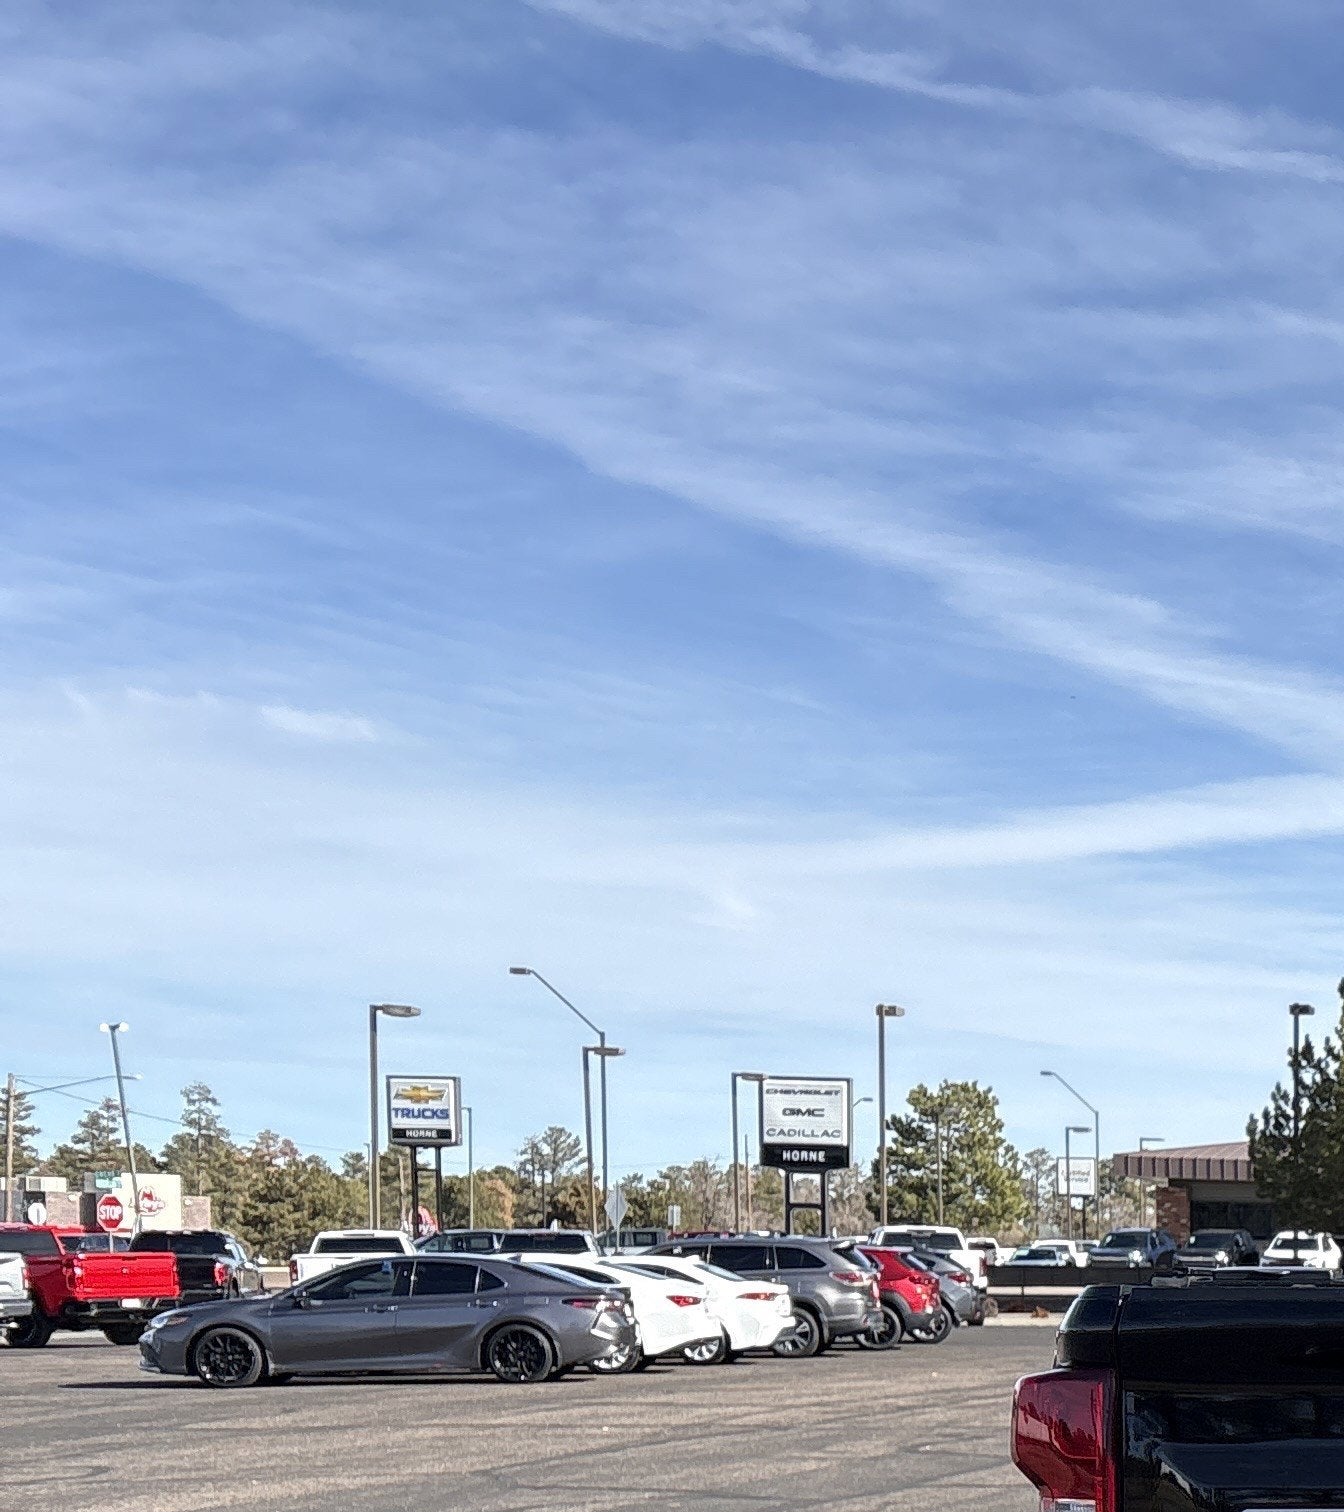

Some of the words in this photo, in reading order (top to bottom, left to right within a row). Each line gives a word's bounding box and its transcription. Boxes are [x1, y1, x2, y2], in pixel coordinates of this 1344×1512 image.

[392, 1107, 449, 1119] TRUCKS
[782, 1108, 825, 1118] GMC
[766, 1128, 841, 1138] CADILLAC
[782, 1150, 826, 1162] HORNE
[99, 1205, 122, 1220] STOP
